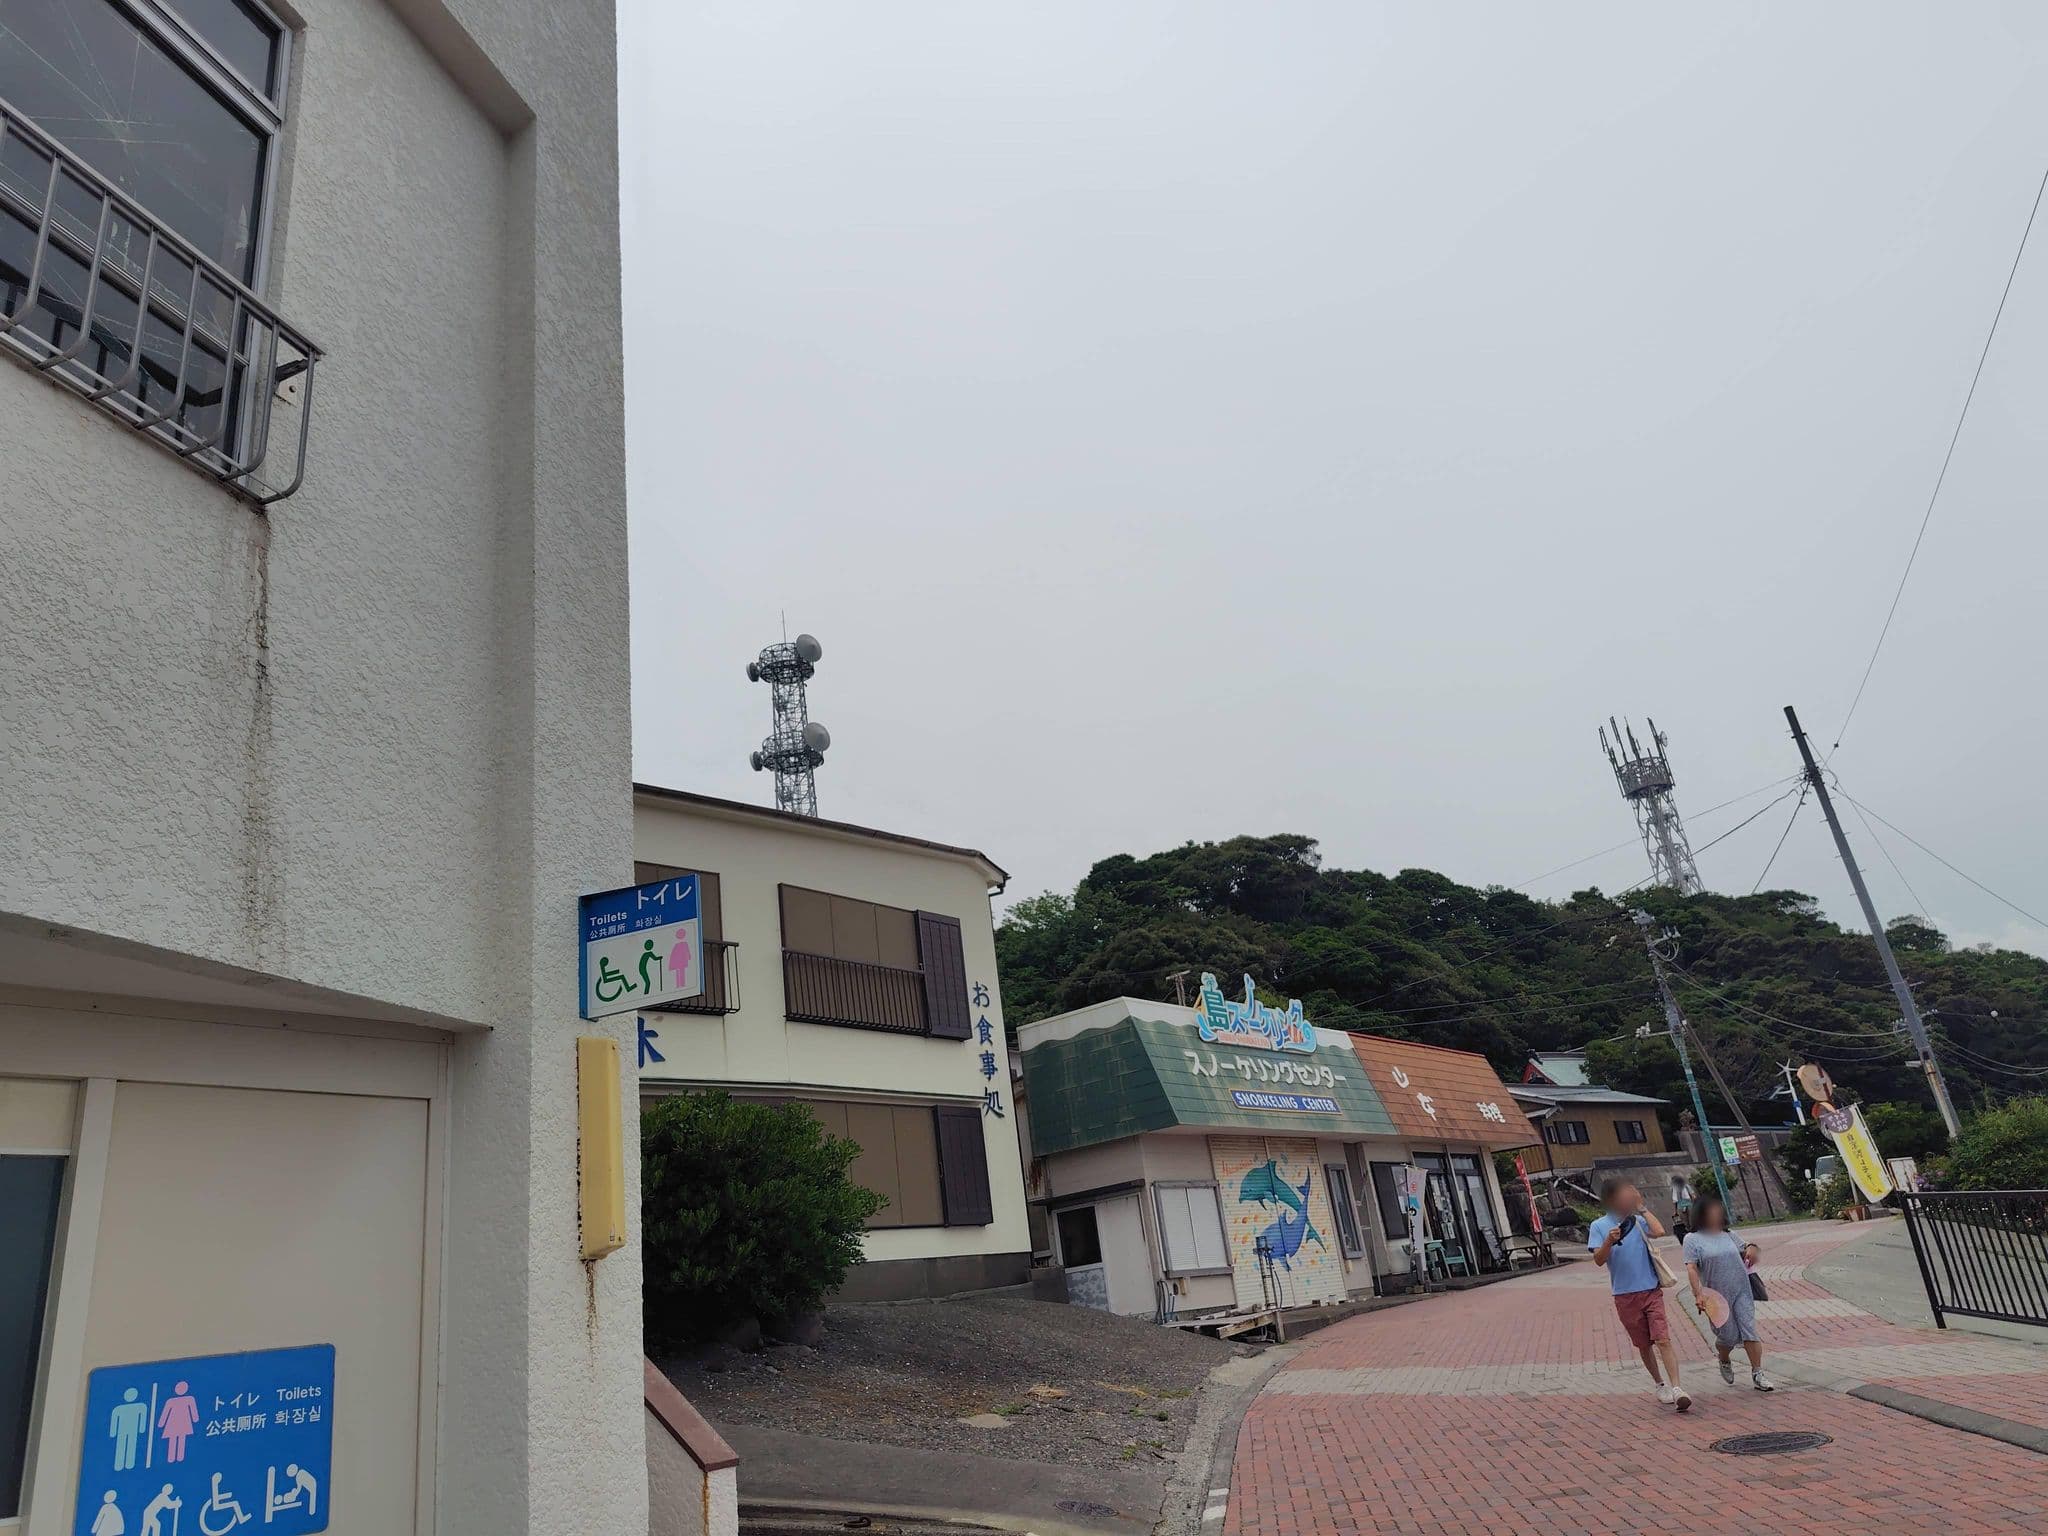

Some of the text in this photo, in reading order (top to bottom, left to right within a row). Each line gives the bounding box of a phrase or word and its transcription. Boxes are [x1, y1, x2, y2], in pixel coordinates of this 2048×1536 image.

[637, 881, 692, 910] トイレ
[590, 911, 628, 926] Toilets
[635, 914, 662, 929] 화장실
[973, 981, 1005, 1119] お食事処
[1184, 1050, 1347, 1089] スノーケリングセンター
[1235, 1092, 1337, 1111] SNORKELING CENTER
[214, 1392, 260, 1412] トイレ
[276, 1385, 322, 1402] Toilets
[274, 1405, 322, 1427] 화장실
